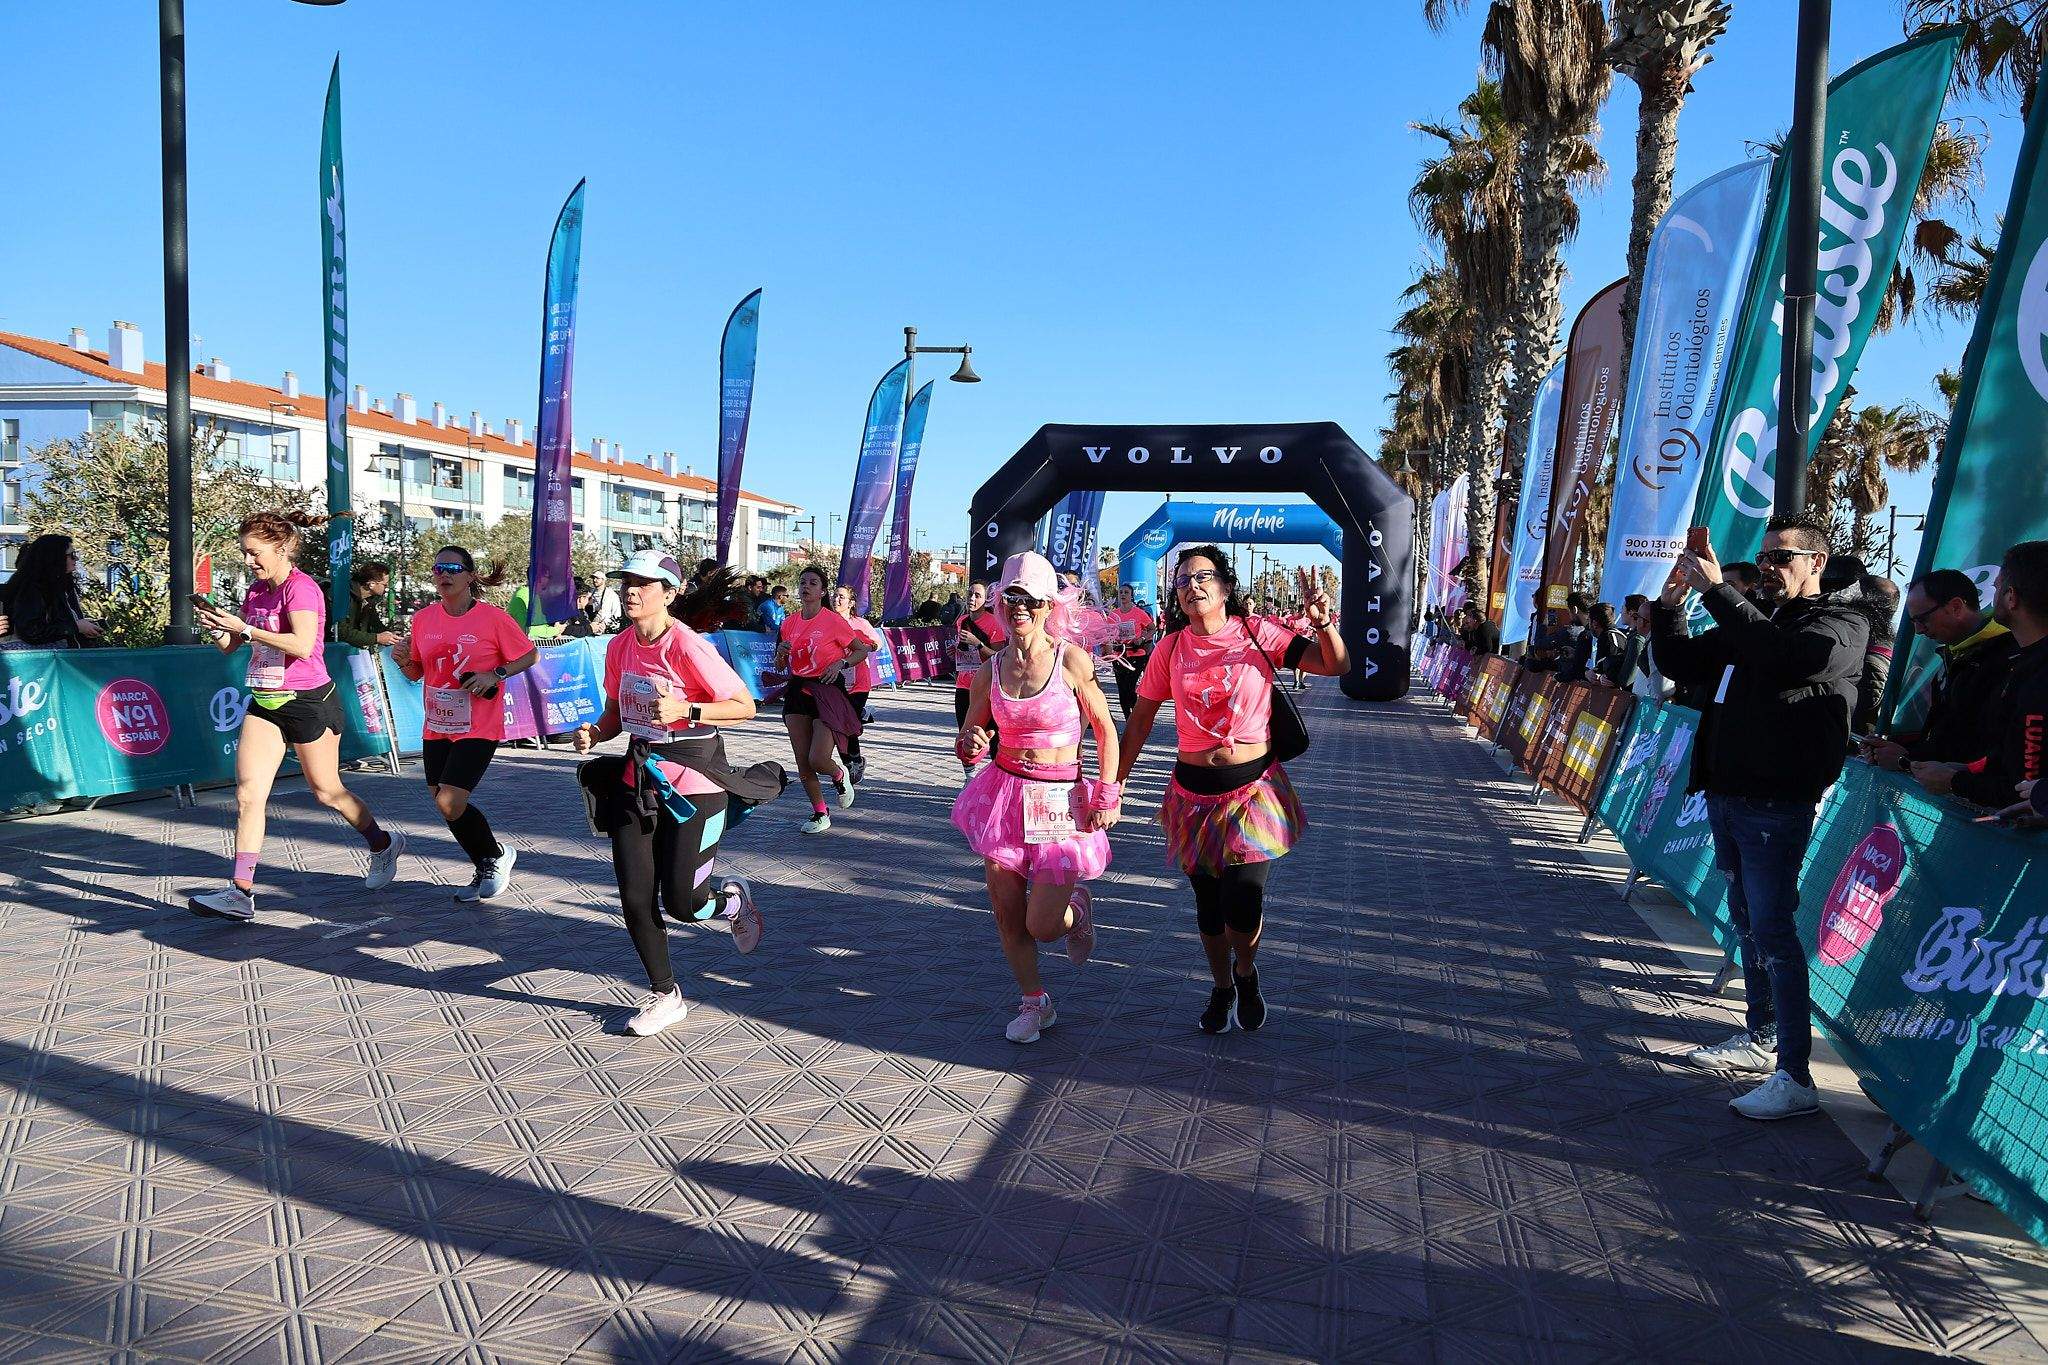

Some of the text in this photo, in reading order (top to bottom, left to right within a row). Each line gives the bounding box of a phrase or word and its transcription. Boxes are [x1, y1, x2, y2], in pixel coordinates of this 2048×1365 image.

[1675, 287, 1711, 420] Odontológicos
[1712, 318, 1728, 370] dentales
[1653, 331, 1682, 419] Institutos
[1570, 402, 1591, 475] Institutos
[1580, 366, 1610, 475] Odontológicos
[1082, 445, 1283, 464] VOLVO
[1212, 507, 1285, 538] Marlene
[1625, 538, 1685, 550] 900 131 00
[1625, 549, 1676, 559] www.ioa.
[1365, 529, 1383, 679] VOLVO
[112, 692, 148, 702] MARCA
[16, 718, 57, 745] SECO
[118, 729, 161, 743] ESPAÑA
[2025, 714, 2044, 781] LUANV
